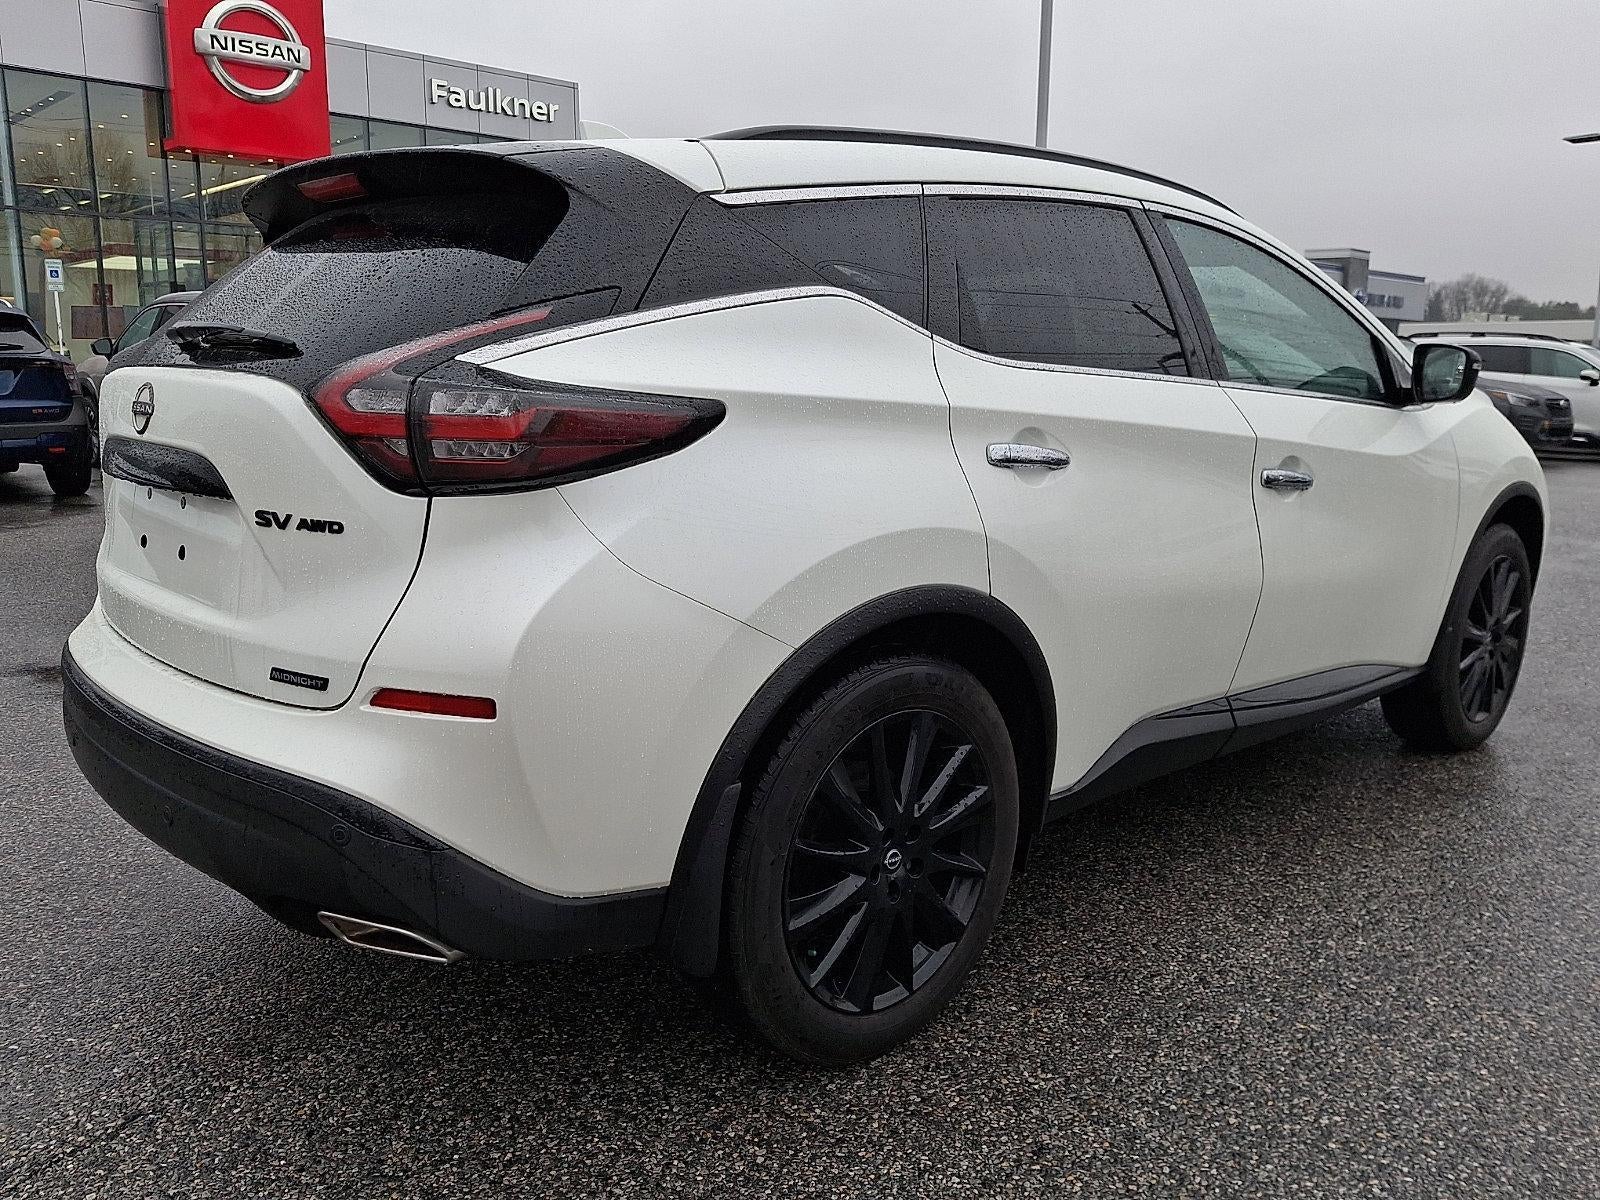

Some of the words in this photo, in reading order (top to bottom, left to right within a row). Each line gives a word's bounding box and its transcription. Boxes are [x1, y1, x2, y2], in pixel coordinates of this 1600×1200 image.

[209, 33, 301, 64] NISSAN
[429, 77, 560, 123] Faulkner
[254, 509, 293, 531] SV
[295, 517, 345, 535] AWD
[271, 670, 324, 688] MIDNIGHT
